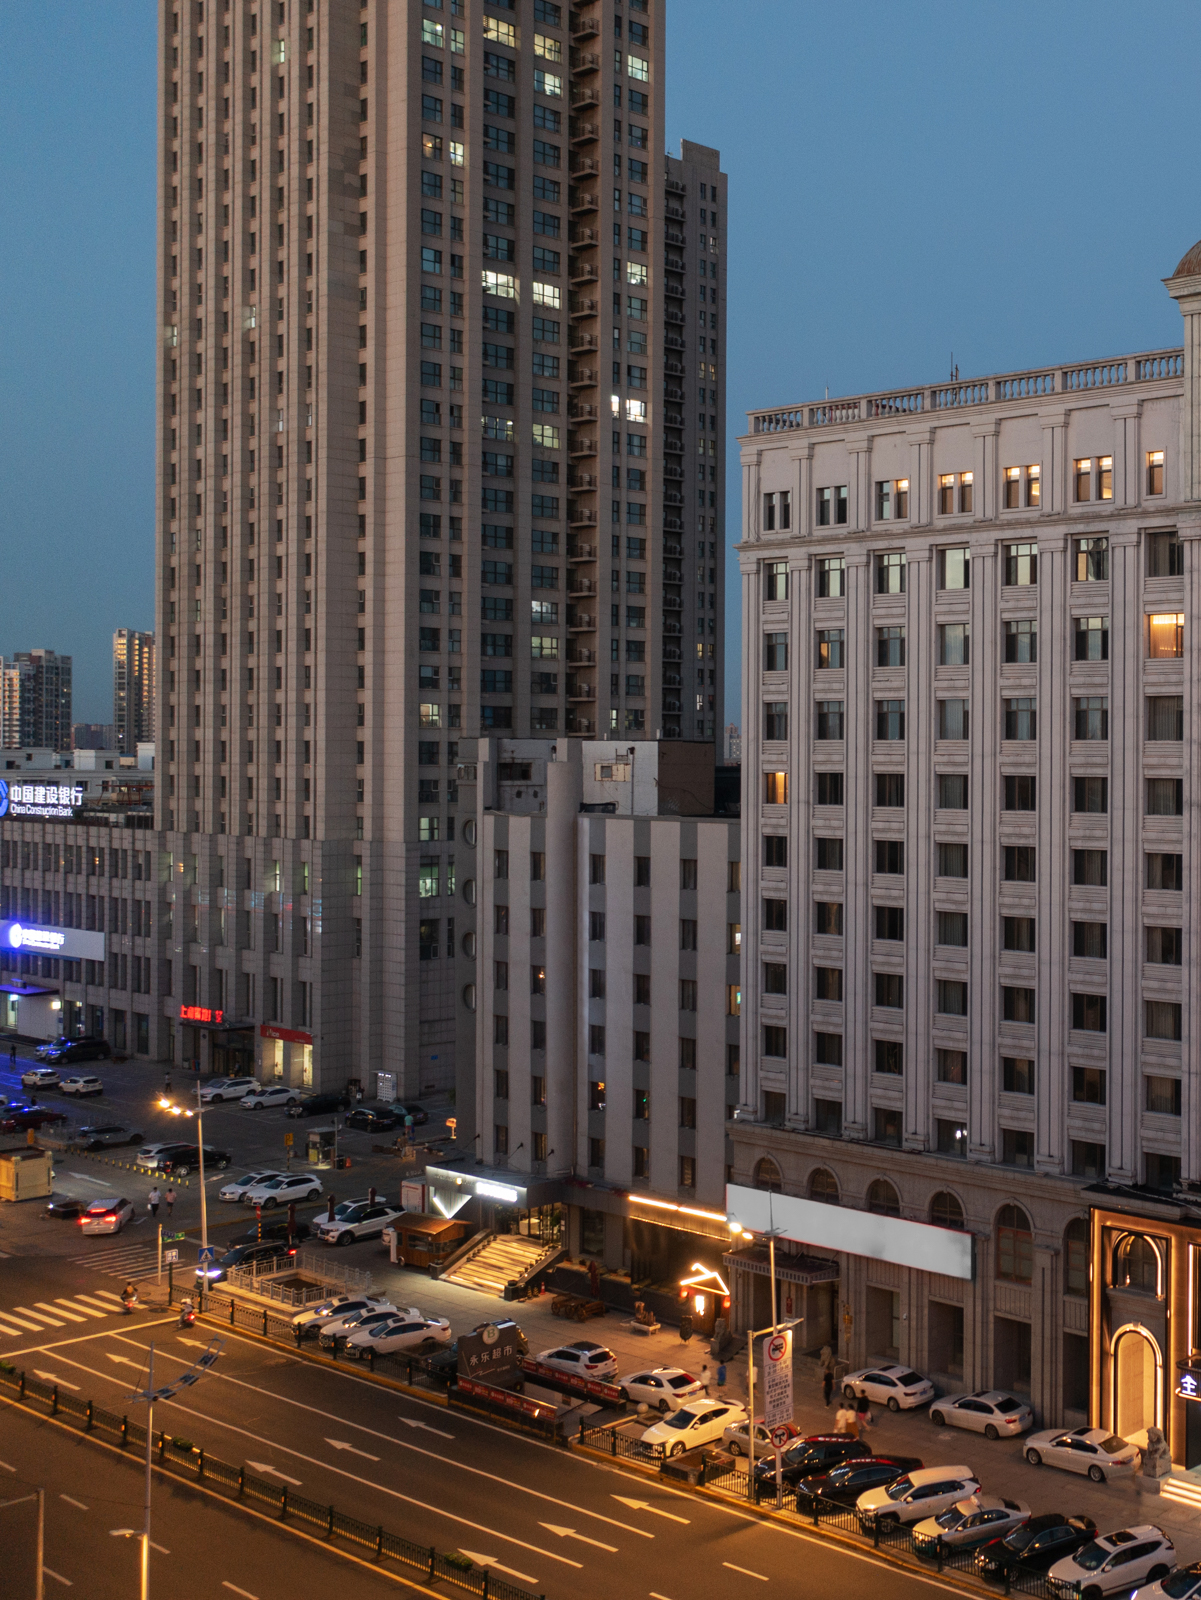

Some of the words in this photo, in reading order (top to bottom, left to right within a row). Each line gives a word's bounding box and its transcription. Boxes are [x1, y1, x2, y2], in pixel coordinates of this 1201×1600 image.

[10, 785, 83, 806] 中国建设银行
[11, 804, 25, 814] China
[26, 805, 58, 816] Construction
[59, 806, 73, 817] Bank
[470, 1345, 512, 1366] 永乐超市
